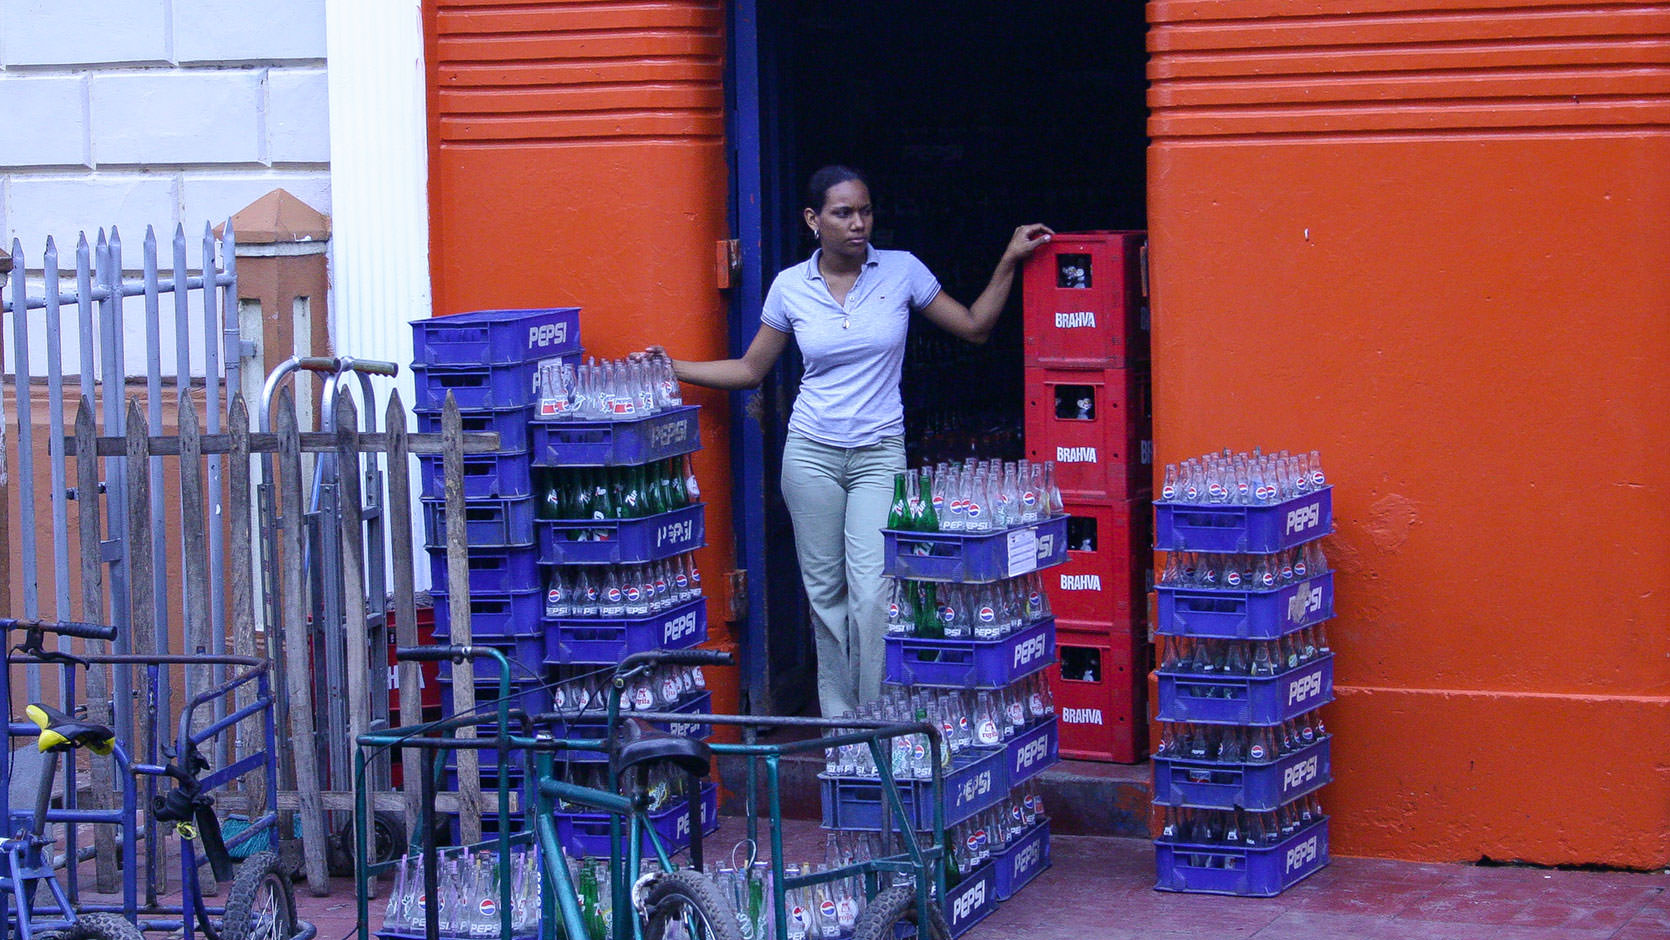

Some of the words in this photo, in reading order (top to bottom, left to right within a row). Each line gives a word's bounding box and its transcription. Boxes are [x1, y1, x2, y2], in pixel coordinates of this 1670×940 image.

[529, 322, 567, 348] PEPSI
[1055, 312, 1096, 328] BRAHVA
[1056, 447, 1097, 463] BRAHVA
[1286, 502, 1319, 535] PEPSI
[1060, 574, 1101, 591] BRAHVA
[664, 611, 697, 644] PEPSI
[1014, 633, 1045, 669] PEPSI
[1288, 671, 1322, 706] PEPSI
[1062, 707, 1103, 725] BRAHVA
[1017, 734, 1048, 772] PEPSI
[1284, 755, 1318, 791] PEPSI
[1013, 839, 1040, 879] PEPSI
[1286, 835, 1317, 874] PEPSI
[953, 879, 986, 925] PEPSI
